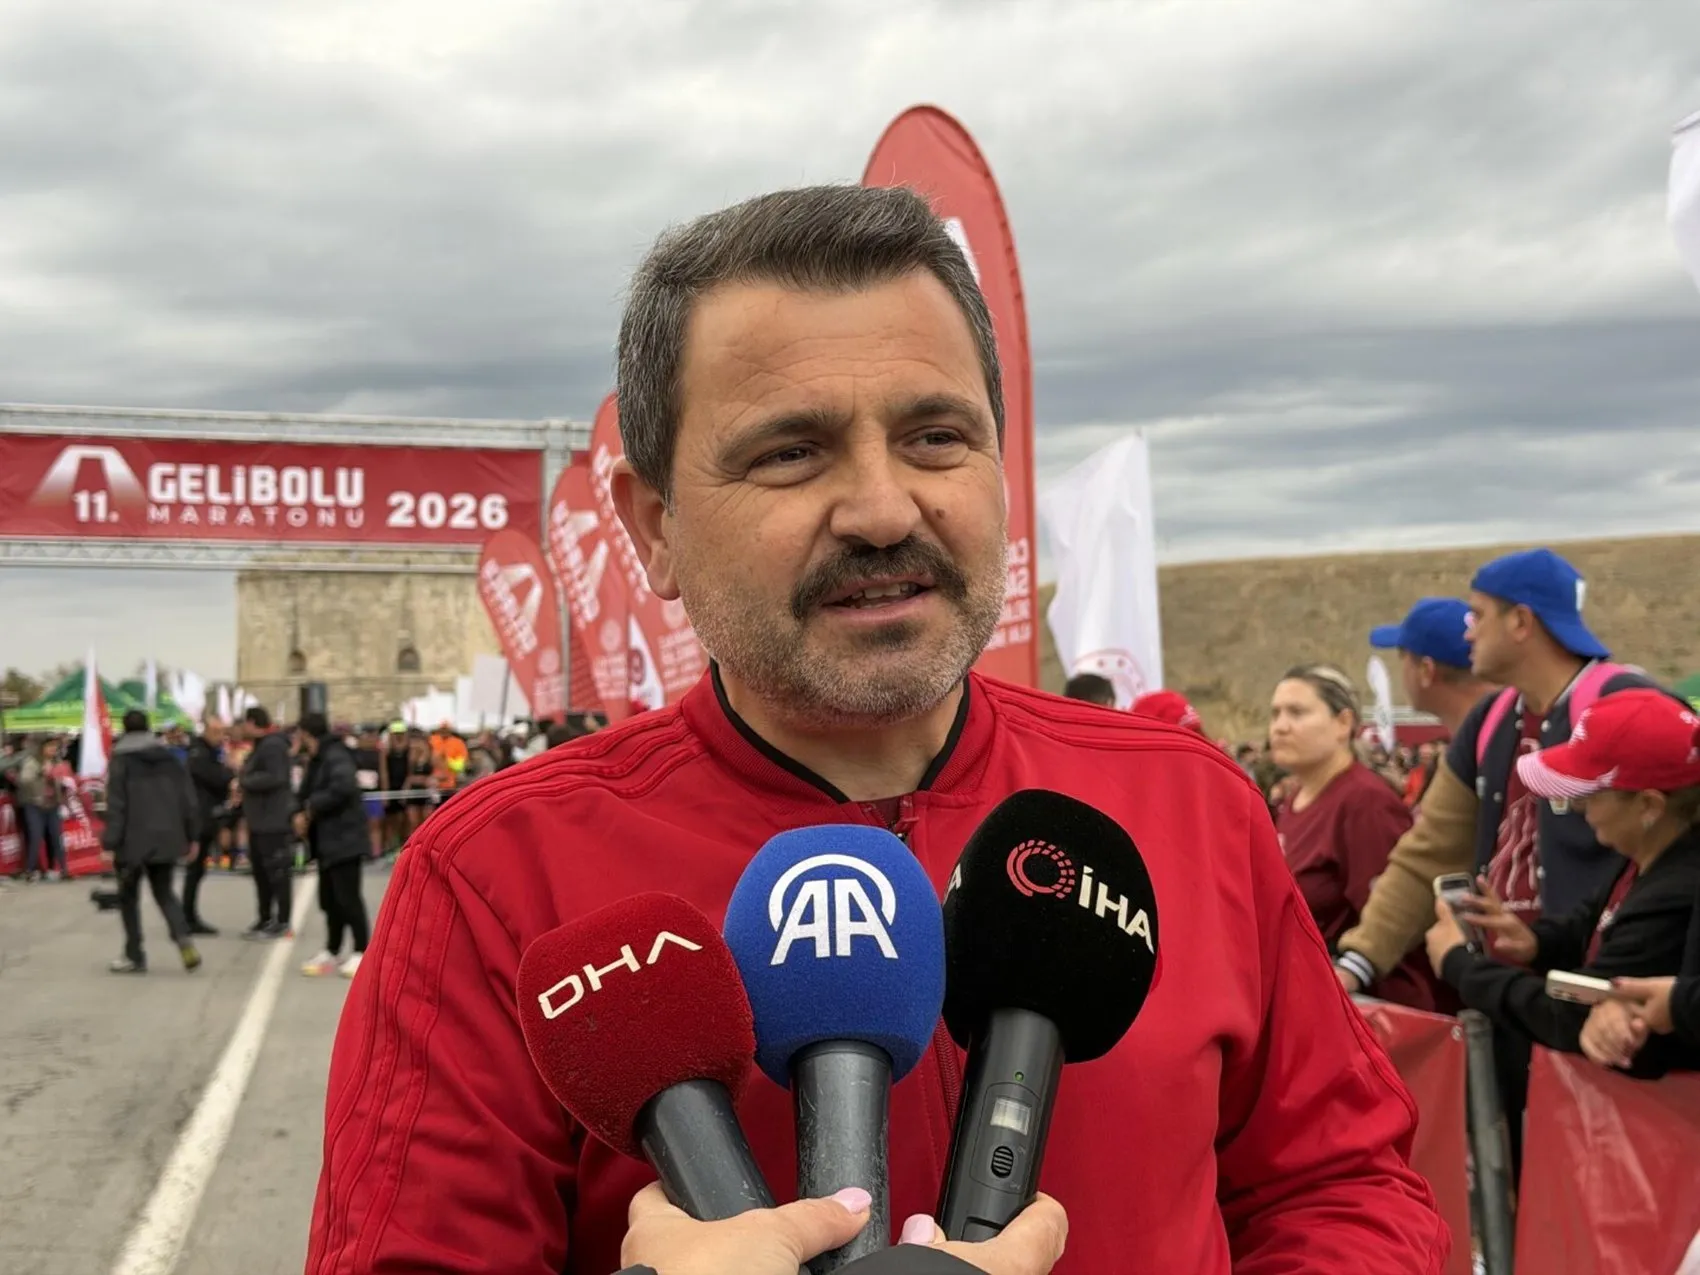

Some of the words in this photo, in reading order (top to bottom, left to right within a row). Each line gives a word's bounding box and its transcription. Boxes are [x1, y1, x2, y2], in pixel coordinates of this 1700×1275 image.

[73, 489, 120, 523] 11.
[148, 505, 364, 528] MARATONU
[386, 491, 508, 529] 2026
[770, 878, 899, 966] AA
[1078, 865, 1155, 954] İHA
[537, 931, 703, 1020] DHA
